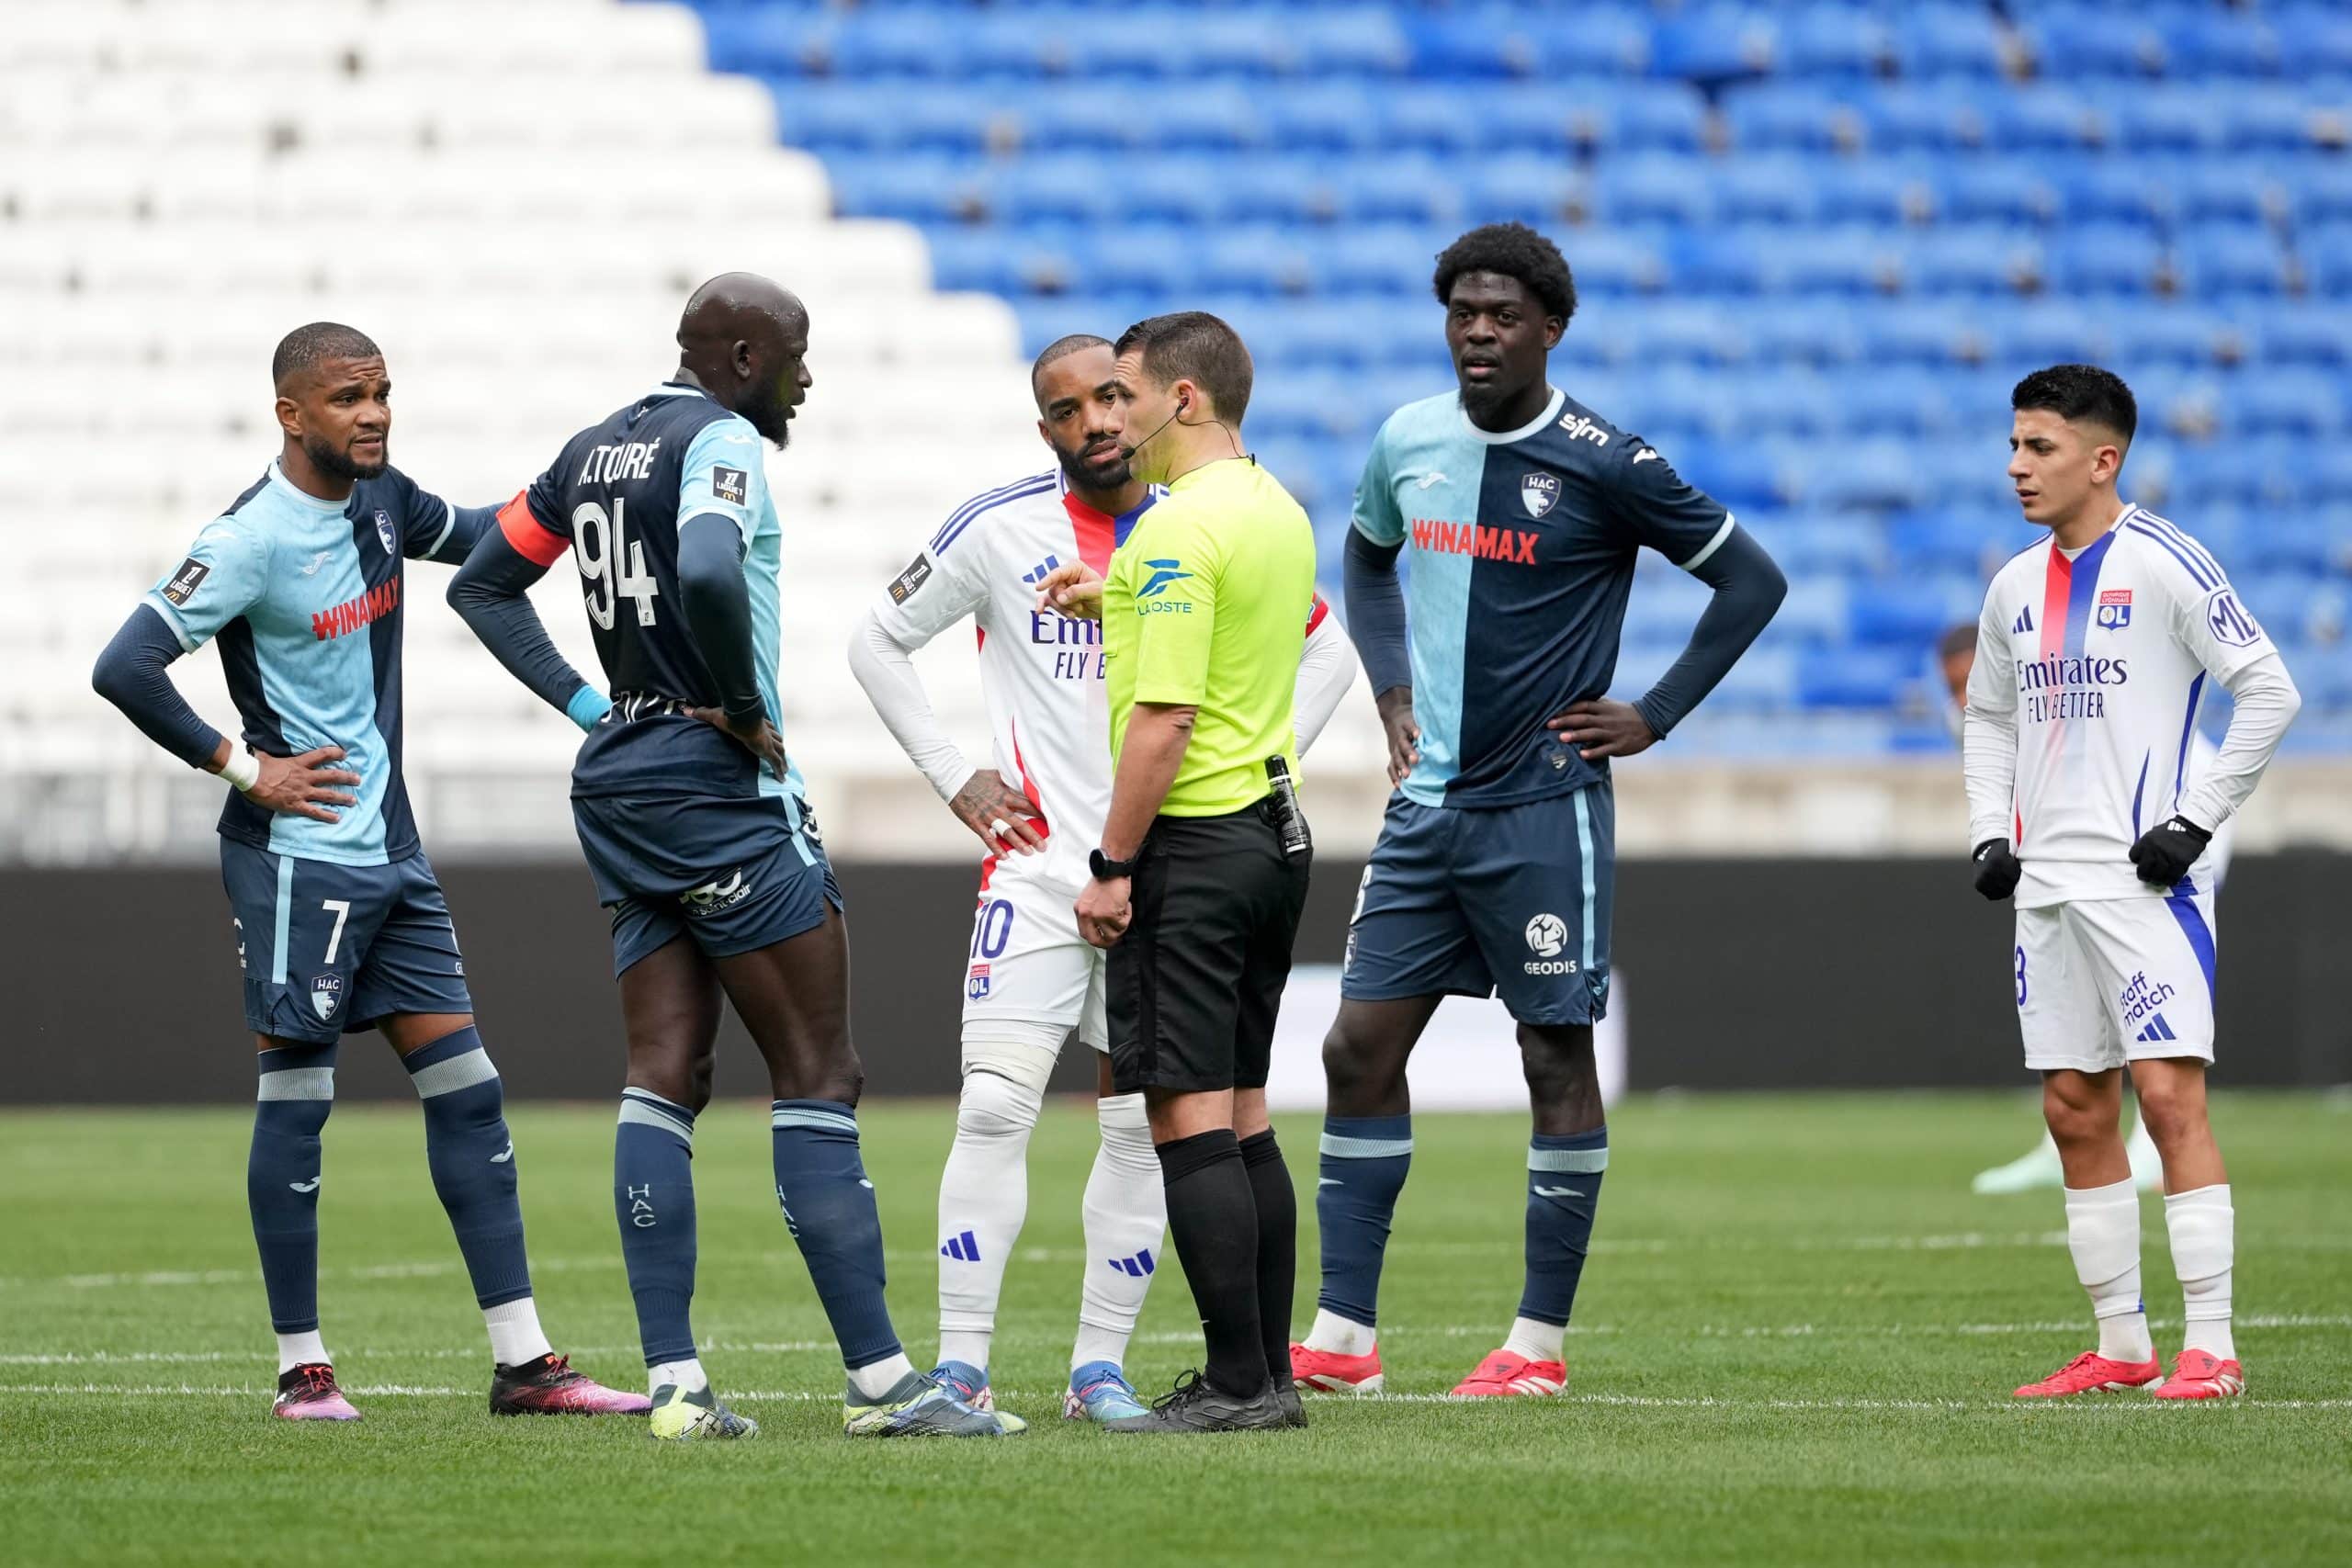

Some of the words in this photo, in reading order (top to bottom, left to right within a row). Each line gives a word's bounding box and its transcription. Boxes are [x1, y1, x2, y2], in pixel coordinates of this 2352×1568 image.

[1529, 476, 1555, 490] HAC
[571, 497, 659, 630] 94
[1412, 518, 1539, 565] WINAMAX
[311, 574, 400, 641] WINAMAX
[1055, 651, 1090, 680] FLY
[2017, 652, 2128, 692] Emirates
[2028, 694, 2048, 724] FLY
[2051, 692, 2104, 719] BETTER
[322, 899, 351, 964] 7
[971, 899, 1014, 959] 10
[317, 978, 340, 990] HAC
[1523, 960, 1577, 976] GEODIS
[2123, 982, 2176, 1029] match
[628, 1183, 657, 1227] HAC
